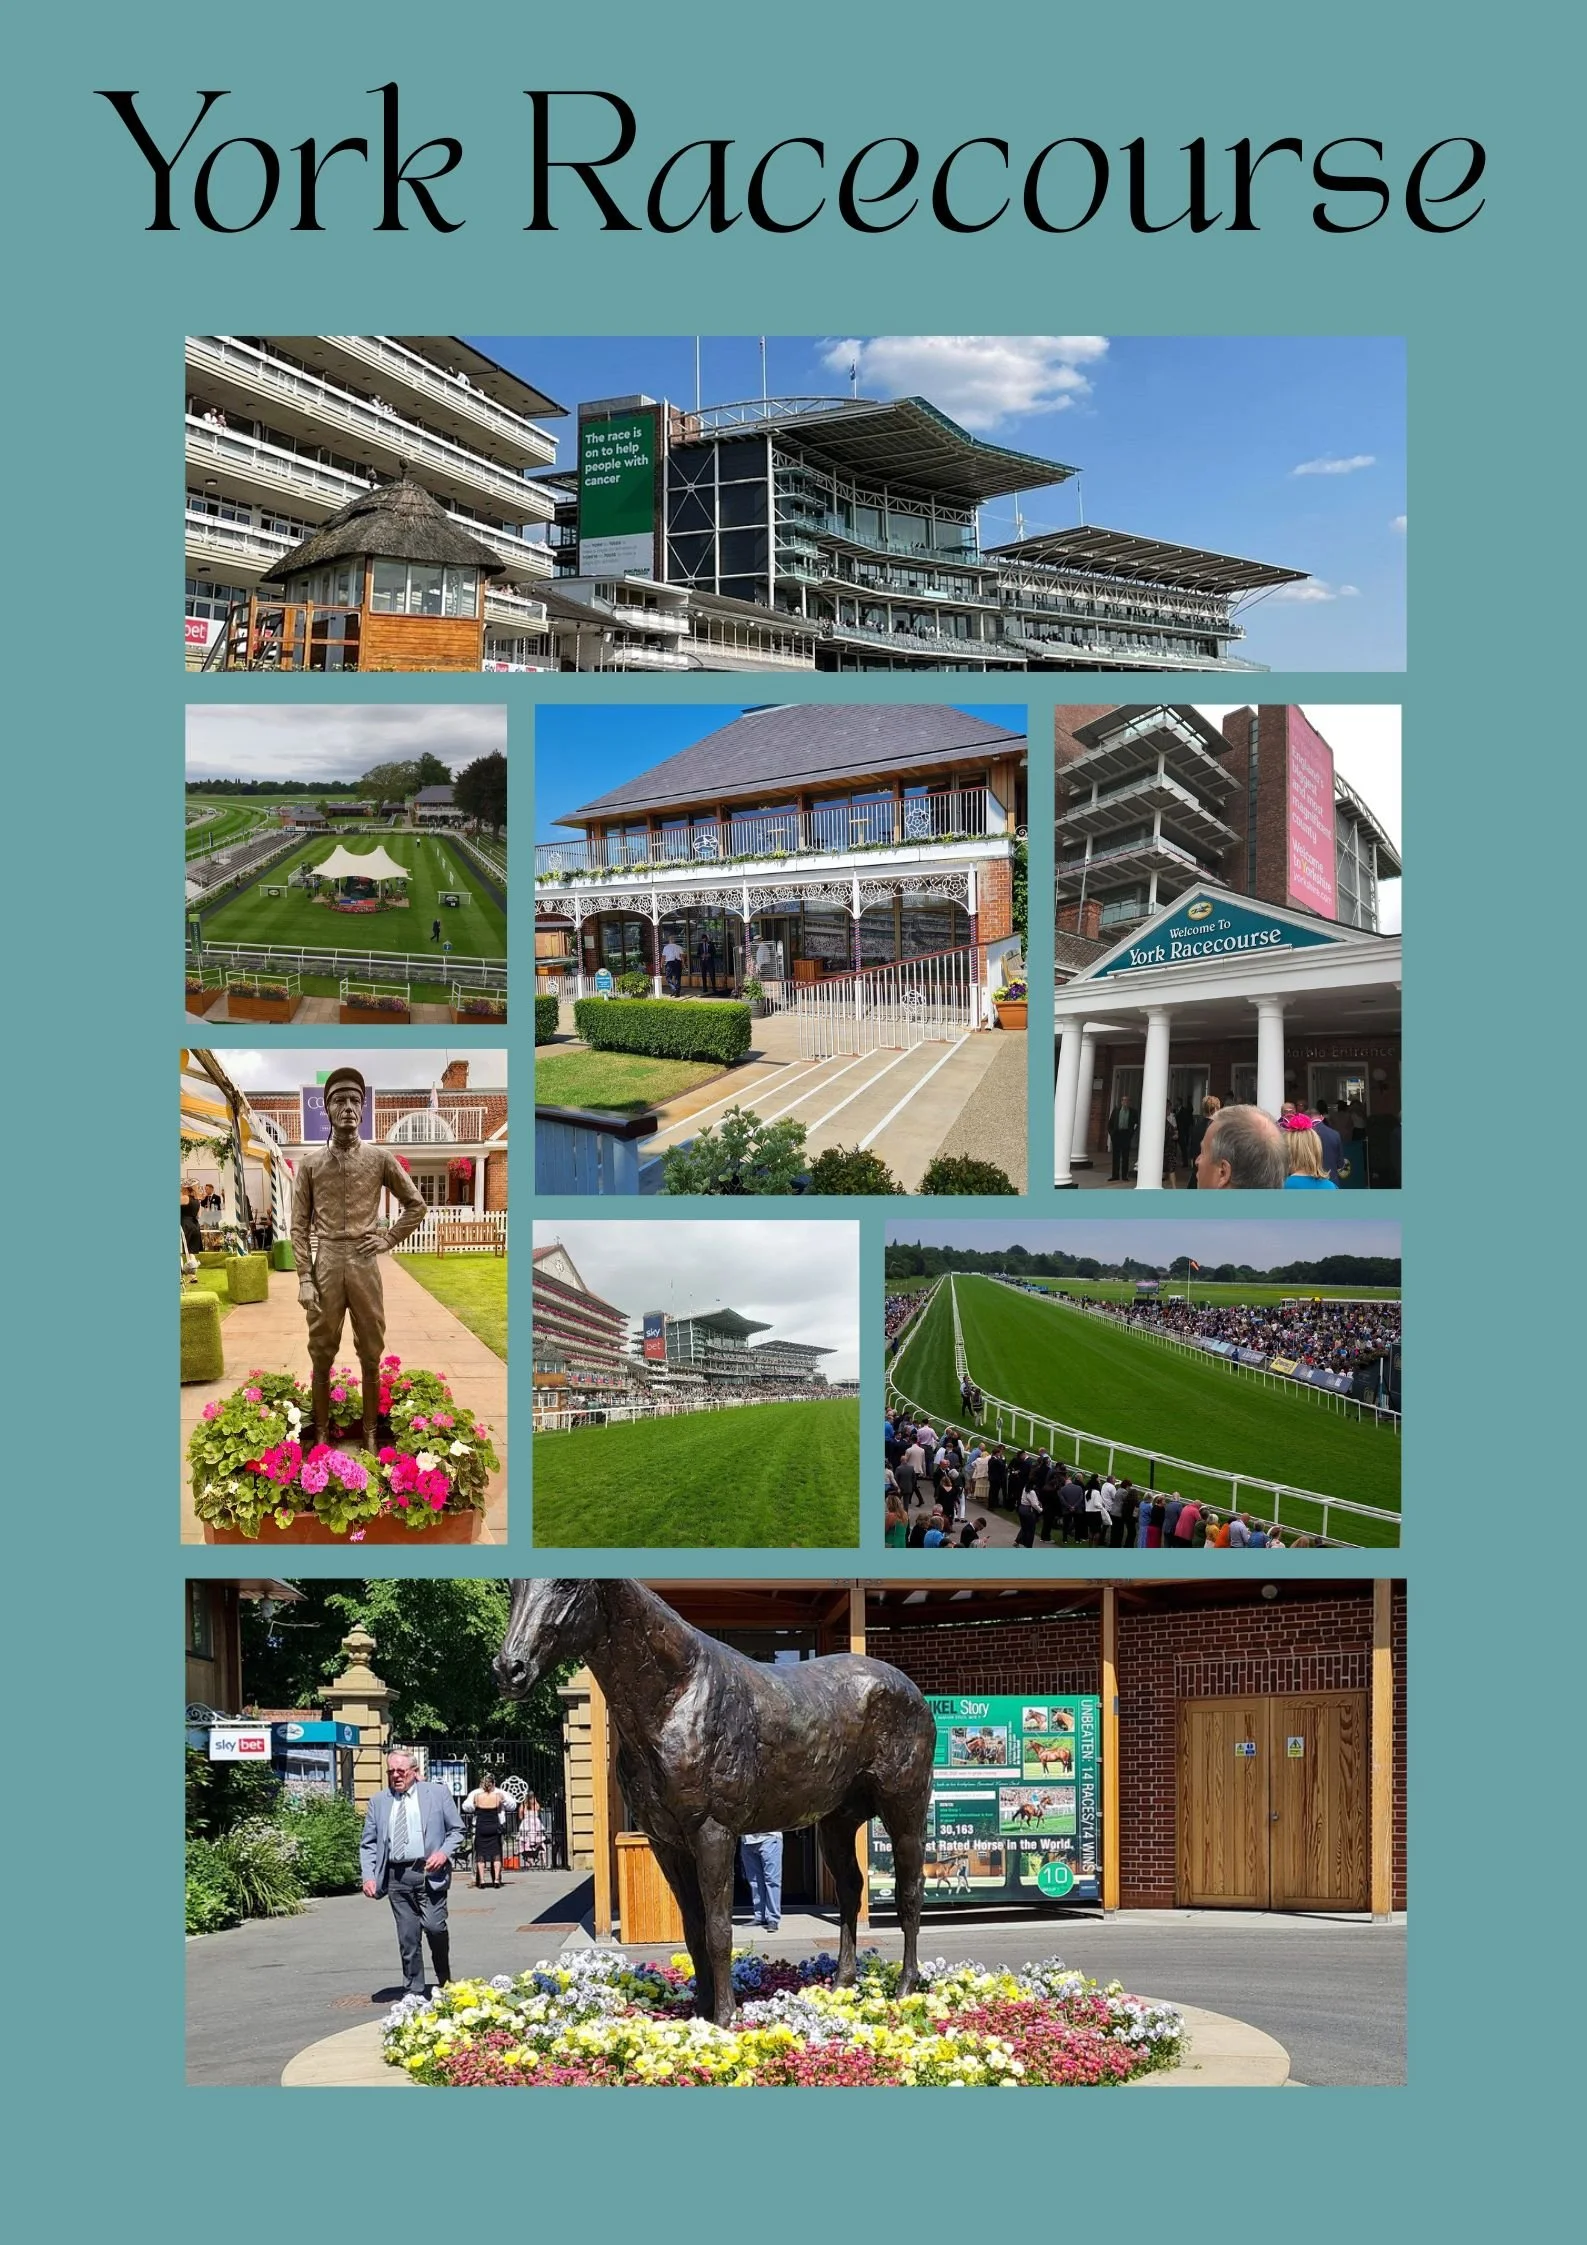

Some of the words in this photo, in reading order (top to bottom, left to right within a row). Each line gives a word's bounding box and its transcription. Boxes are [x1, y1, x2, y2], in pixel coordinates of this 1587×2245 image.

[585, 432, 605, 444] The
[607, 431, 631, 441] race
[633, 426, 642, 438] is
[585, 449, 599, 458] on
[601, 447, 613, 456] to
[616, 441, 639, 455] help
[584, 458, 622, 475] people
[623, 454, 649, 467] with
[584, 475, 621, 486] cancer
[1292, 811, 1317, 845] county
[1292, 836, 1324, 874] Welcome
[1301, 858, 1332, 893] Yorkshire
[1169, 922, 1216, 939] Welcome
[1218, 919, 1231, 930] To
[1129, 945, 1165, 967] York
[1170, 929, 1282, 960] Racecourse
[645, 1328, 661, 1338] sky
[646, 1341, 662, 1351] bet
[928, 1699, 958, 1715] KEL
[960, 1699, 990, 1718] Story
[1080, 1699, 1094, 1763] UNBEATEN:
[215, 1739, 236, 1752] sky
[240, 1739, 264, 1750] bet
[1081, 1766, 1094, 1780] 14
[1081, 1783, 1095, 1839] RACES/14
[940, 1824, 974, 1836] 30,163
[872, 1840, 893, 1852] The
[939, 1839, 970, 1851] Rated
[973, 1839, 1004, 1851] Horse
[1007, 1839, 1017, 1850] in
[1020, 1838, 1037, 1850] the
[1039, 1837, 1075, 1849] World.
[1082, 1841, 1096, 1873] WINS
[1043, 1866, 1068, 1884] 10
